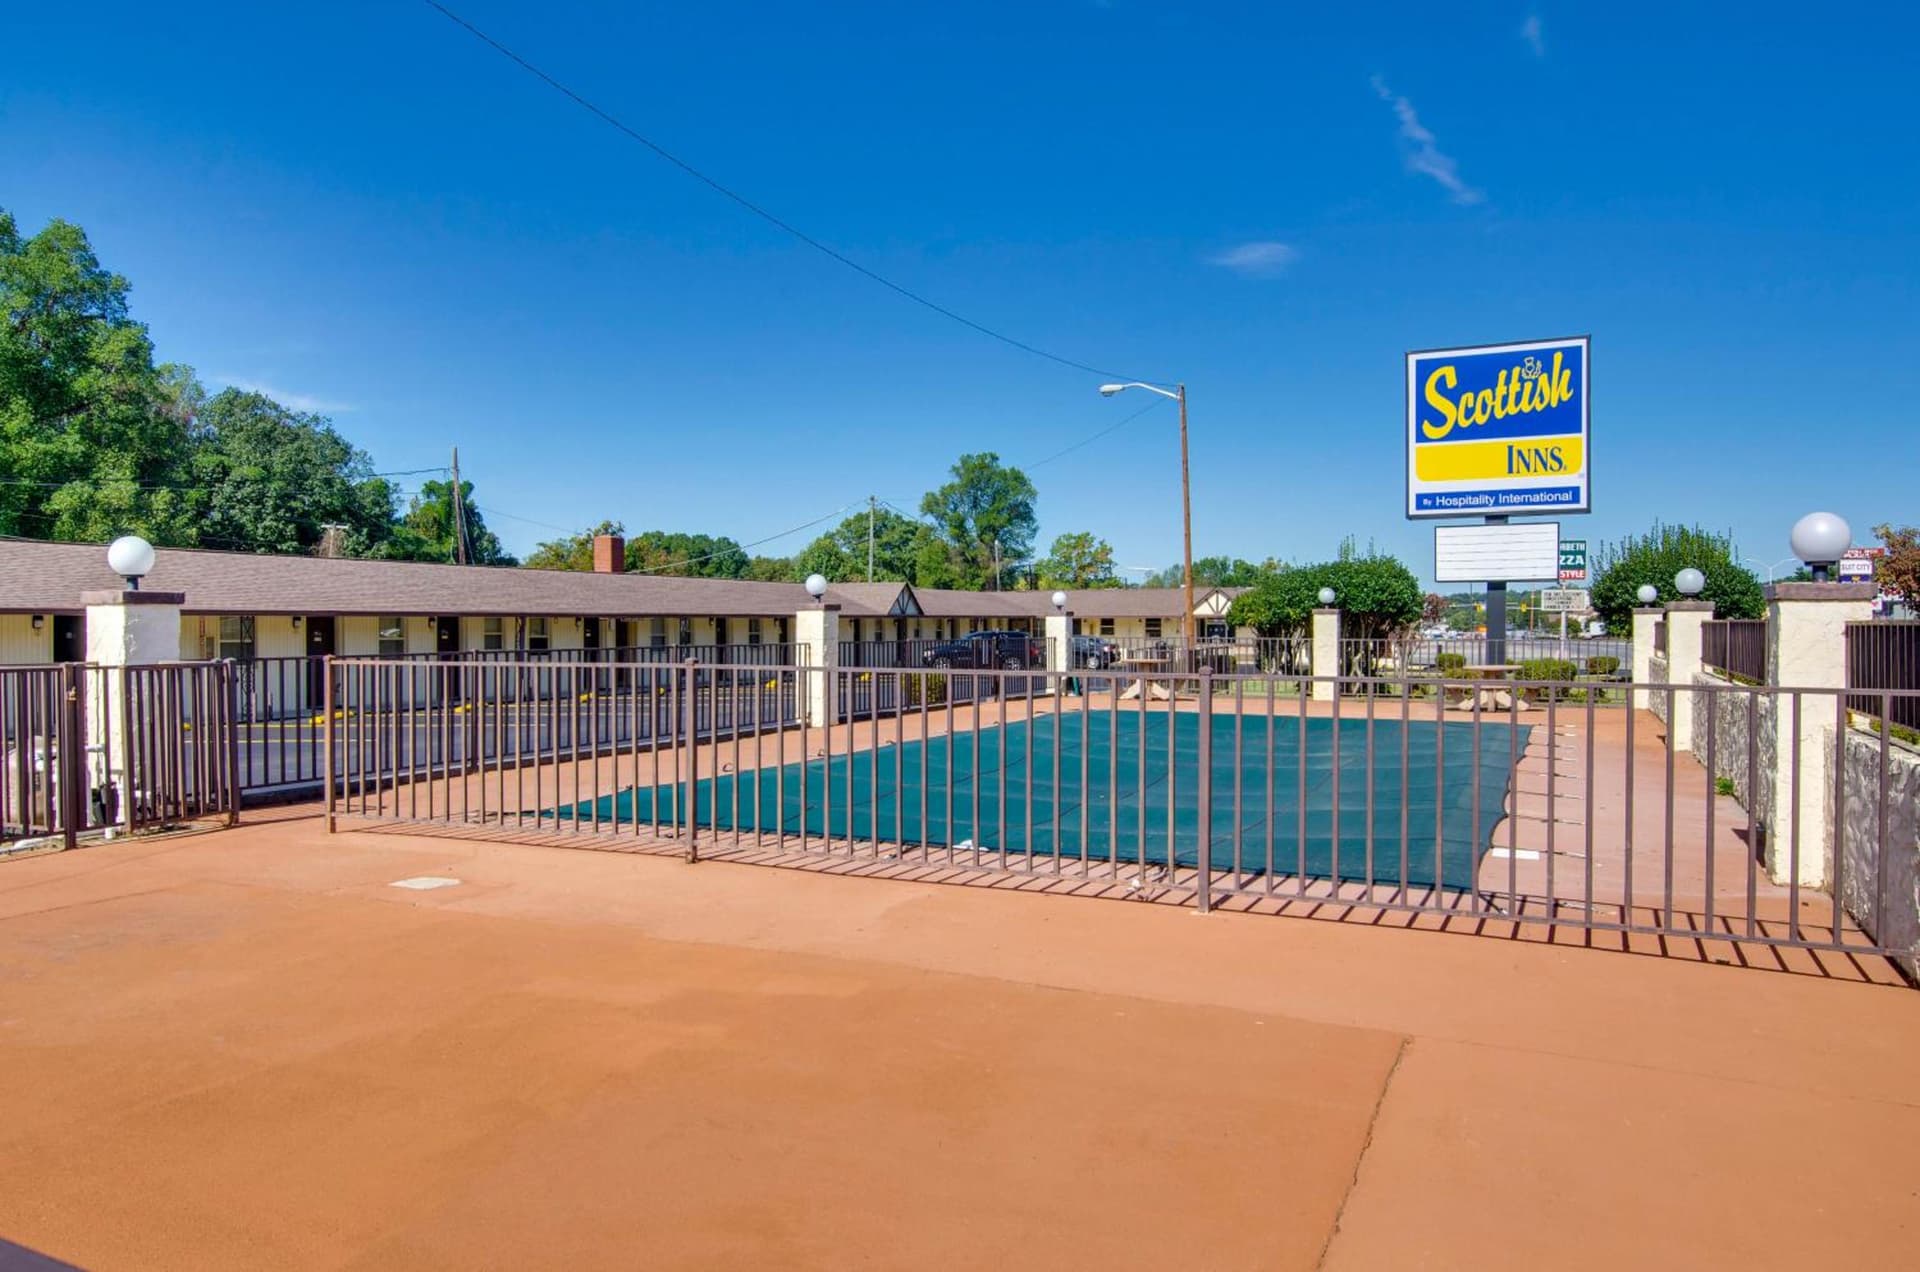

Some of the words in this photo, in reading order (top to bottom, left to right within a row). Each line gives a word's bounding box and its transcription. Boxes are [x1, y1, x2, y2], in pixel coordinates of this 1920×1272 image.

[1422, 351, 1574, 439] Scottish
[1507, 445, 1564, 475] INNS
[1435, 494, 1495, 508] Hospitality
[1499, 491, 1573, 504] International
[1560, 569, 1584, 578] STYLE
